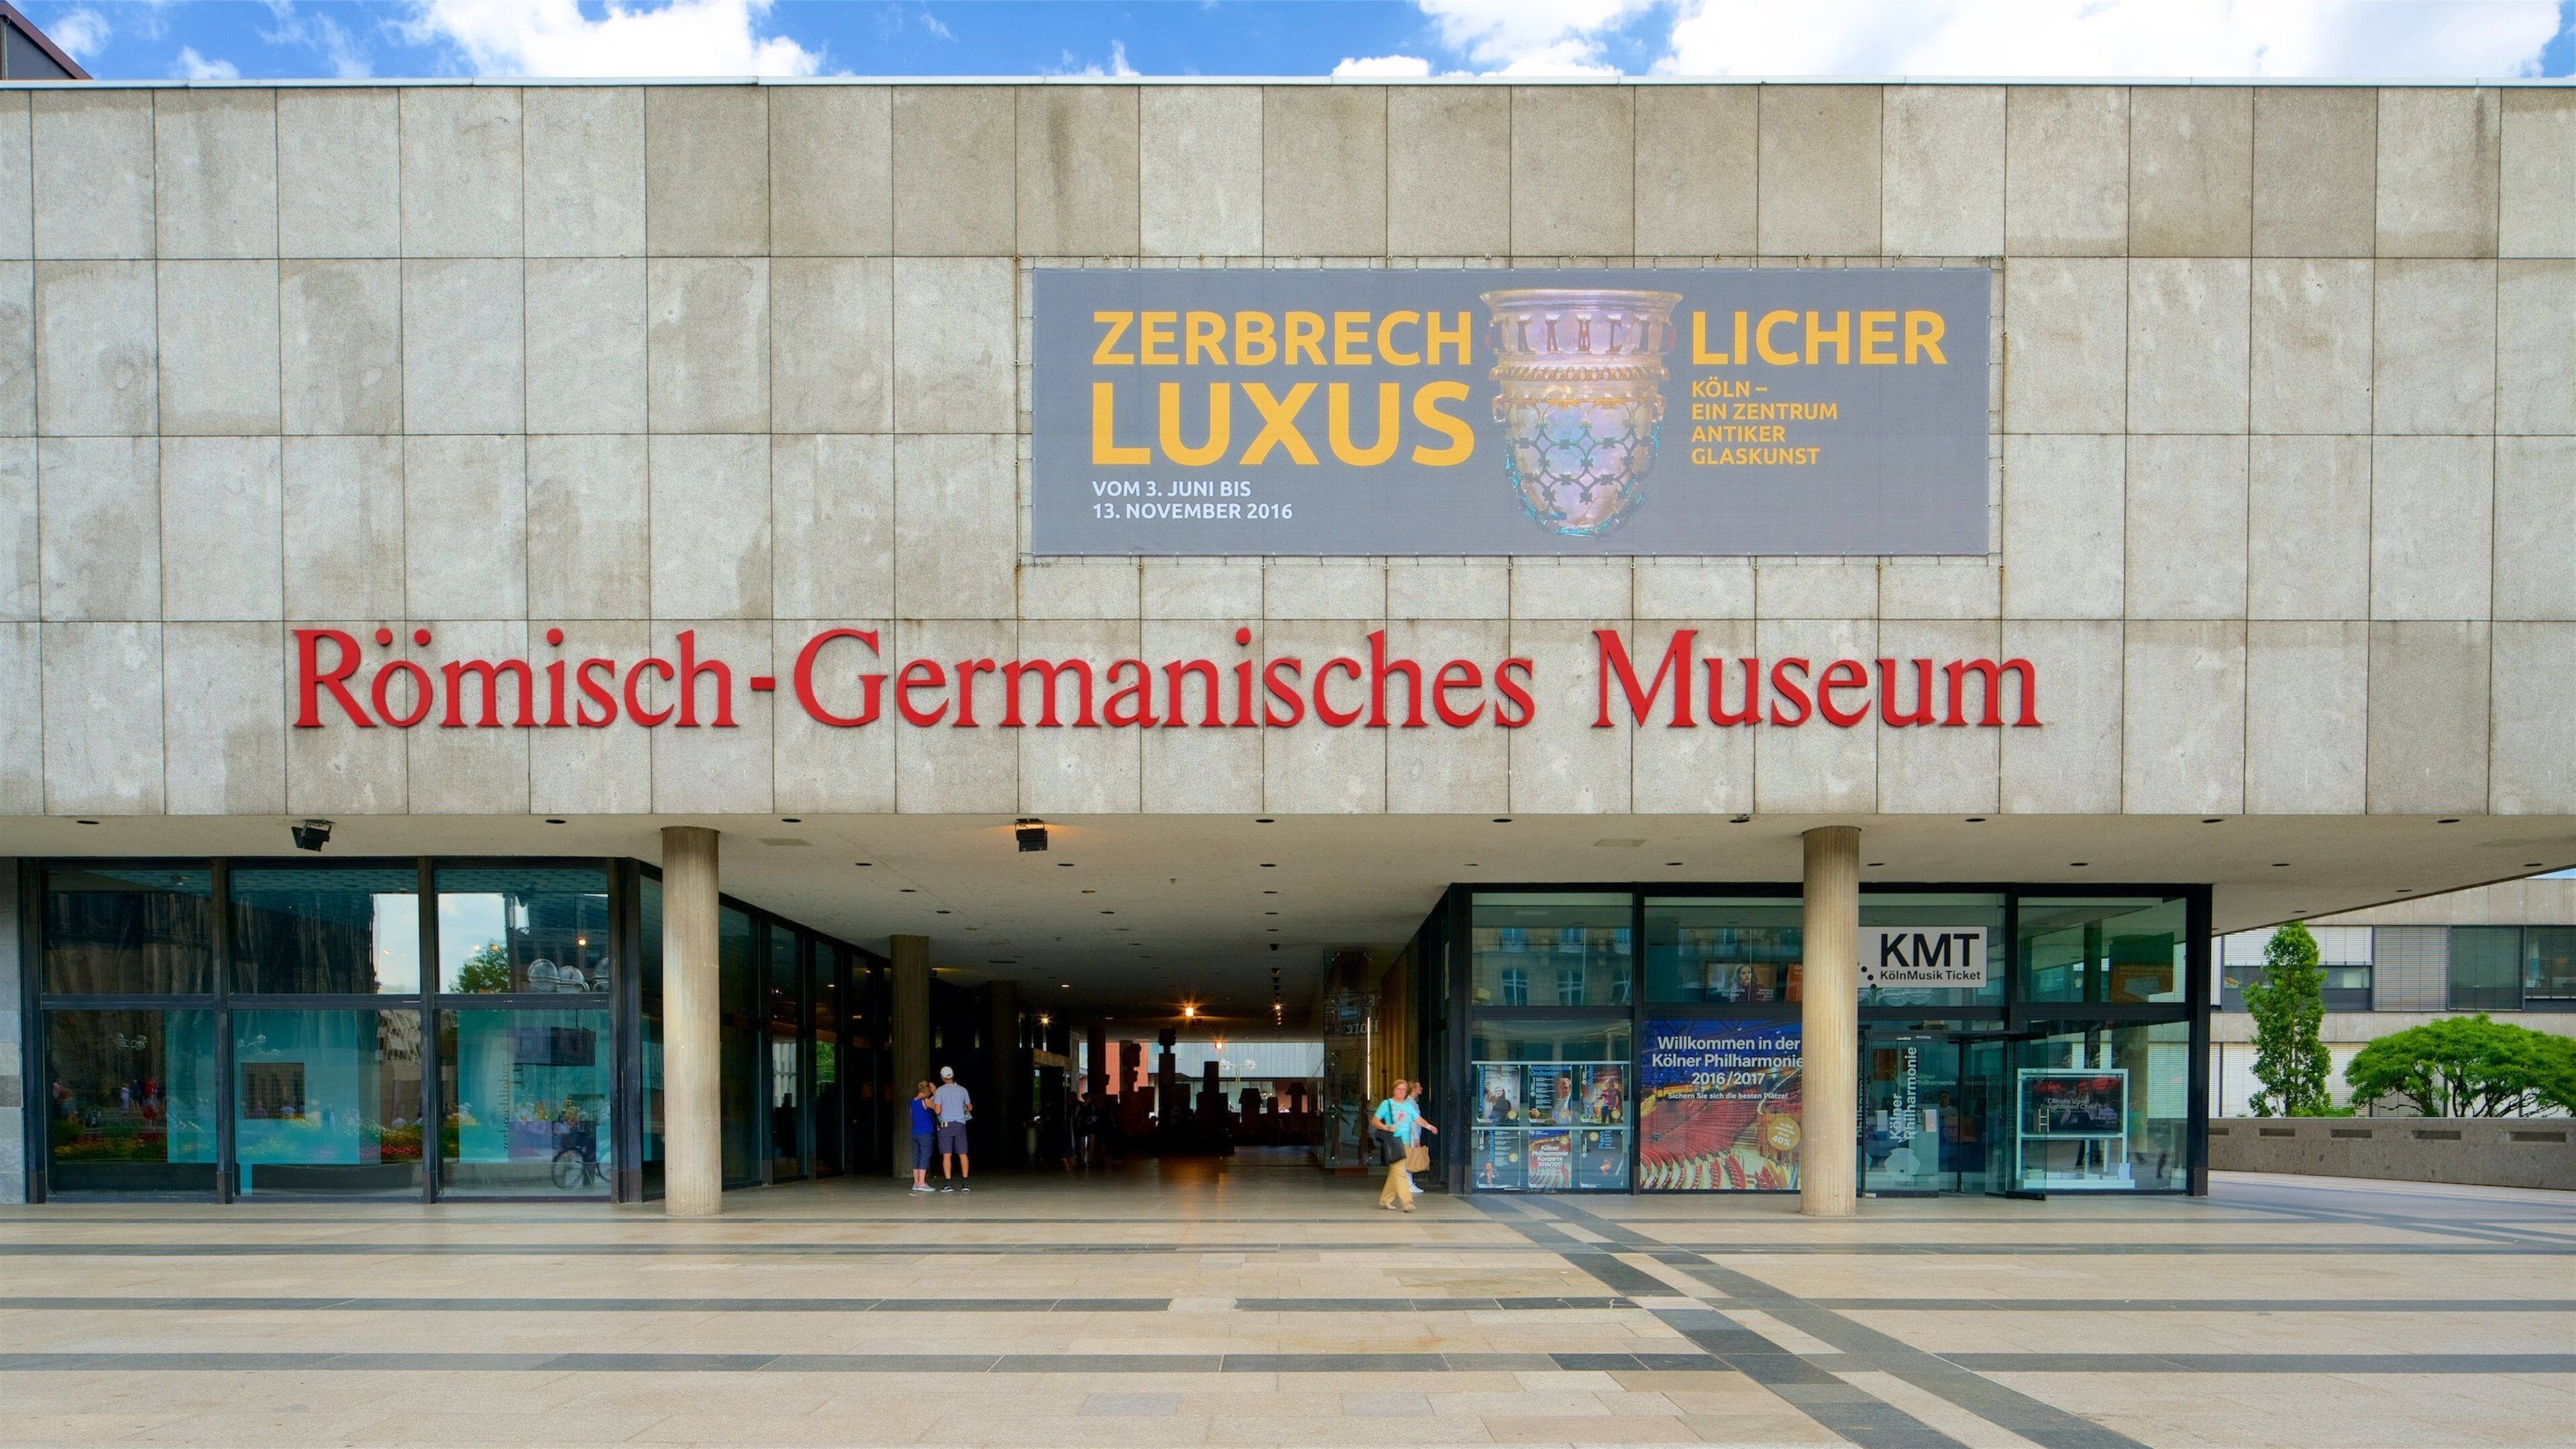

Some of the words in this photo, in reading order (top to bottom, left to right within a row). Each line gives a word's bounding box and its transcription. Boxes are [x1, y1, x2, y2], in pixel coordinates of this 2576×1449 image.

[1092, 310, 1472, 366] ZERBRECH
[1692, 309, 1947, 366] LICHER
[1691, 376, 1751, 398] KÖLN
[1691, 402, 1727, 421] EIN
[1733, 402, 1837, 421] ZENTRUM
[1092, 380, 1475, 467] LUXUS
[1690, 425, 1786, 443] ANTIKER
[1690, 447, 1821, 465] GLASKUNST
[1092, 481, 1140, 496] VOM
[1146, 481, 1162, 496] 3.
[1167, 481, 1214, 496] JUNI
[1220, 481, 1251, 496] BIS
[1093, 503, 1120, 519] 13.
[1126, 503, 1241, 519] NOVEMBER
[1247, 503, 1293, 519] 2016
[294, 627, 1536, 728] Römisch-Germanisches
[1595, 629, 2039, 727] Museum
[1880, 933, 1980, 967] KMT
[1880, 970, 1943, 980] KölnMusik
[1945, 970, 1981, 980] Ticket
[1657, 1036, 1755, 1050] Willkommen
[1758, 1036, 1772, 1050] in
[1775, 1036, 1801, 1050] der
[1652, 1053, 1702, 1067] Kölner
[1705, 1053, 1803, 1068] Philharmonie
[1691, 1071, 1766, 1086] 2016/2017
[1904, 1046, 1917, 1139] Philharmonie
[1890, 1093, 1902, 1140] Kölner
[1772, 1135, 1790, 1146] 40%
